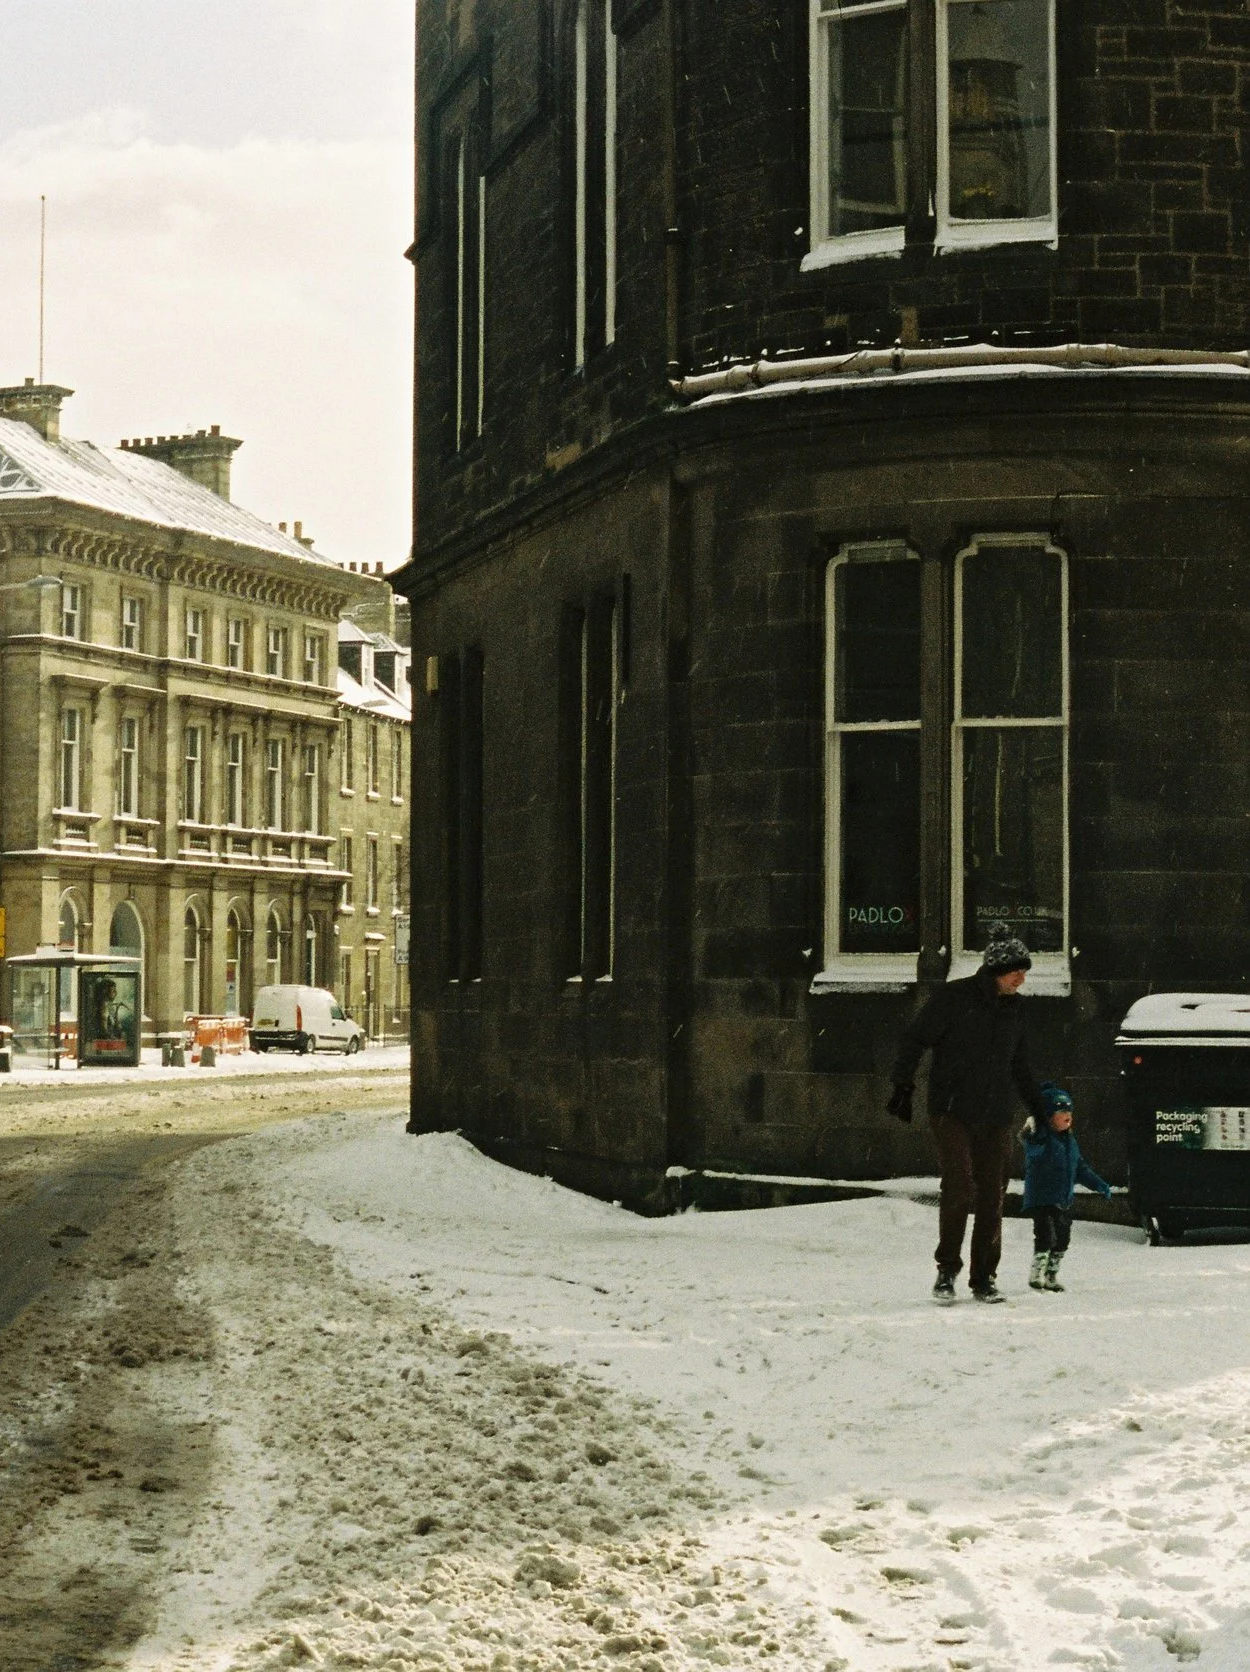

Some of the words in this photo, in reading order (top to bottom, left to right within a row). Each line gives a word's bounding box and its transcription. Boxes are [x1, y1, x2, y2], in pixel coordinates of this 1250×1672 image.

[1156, 1111, 1209, 1124] Packaging
[1156, 1122, 1201, 1134] recycling
[1156, 1132, 1184, 1144] point
